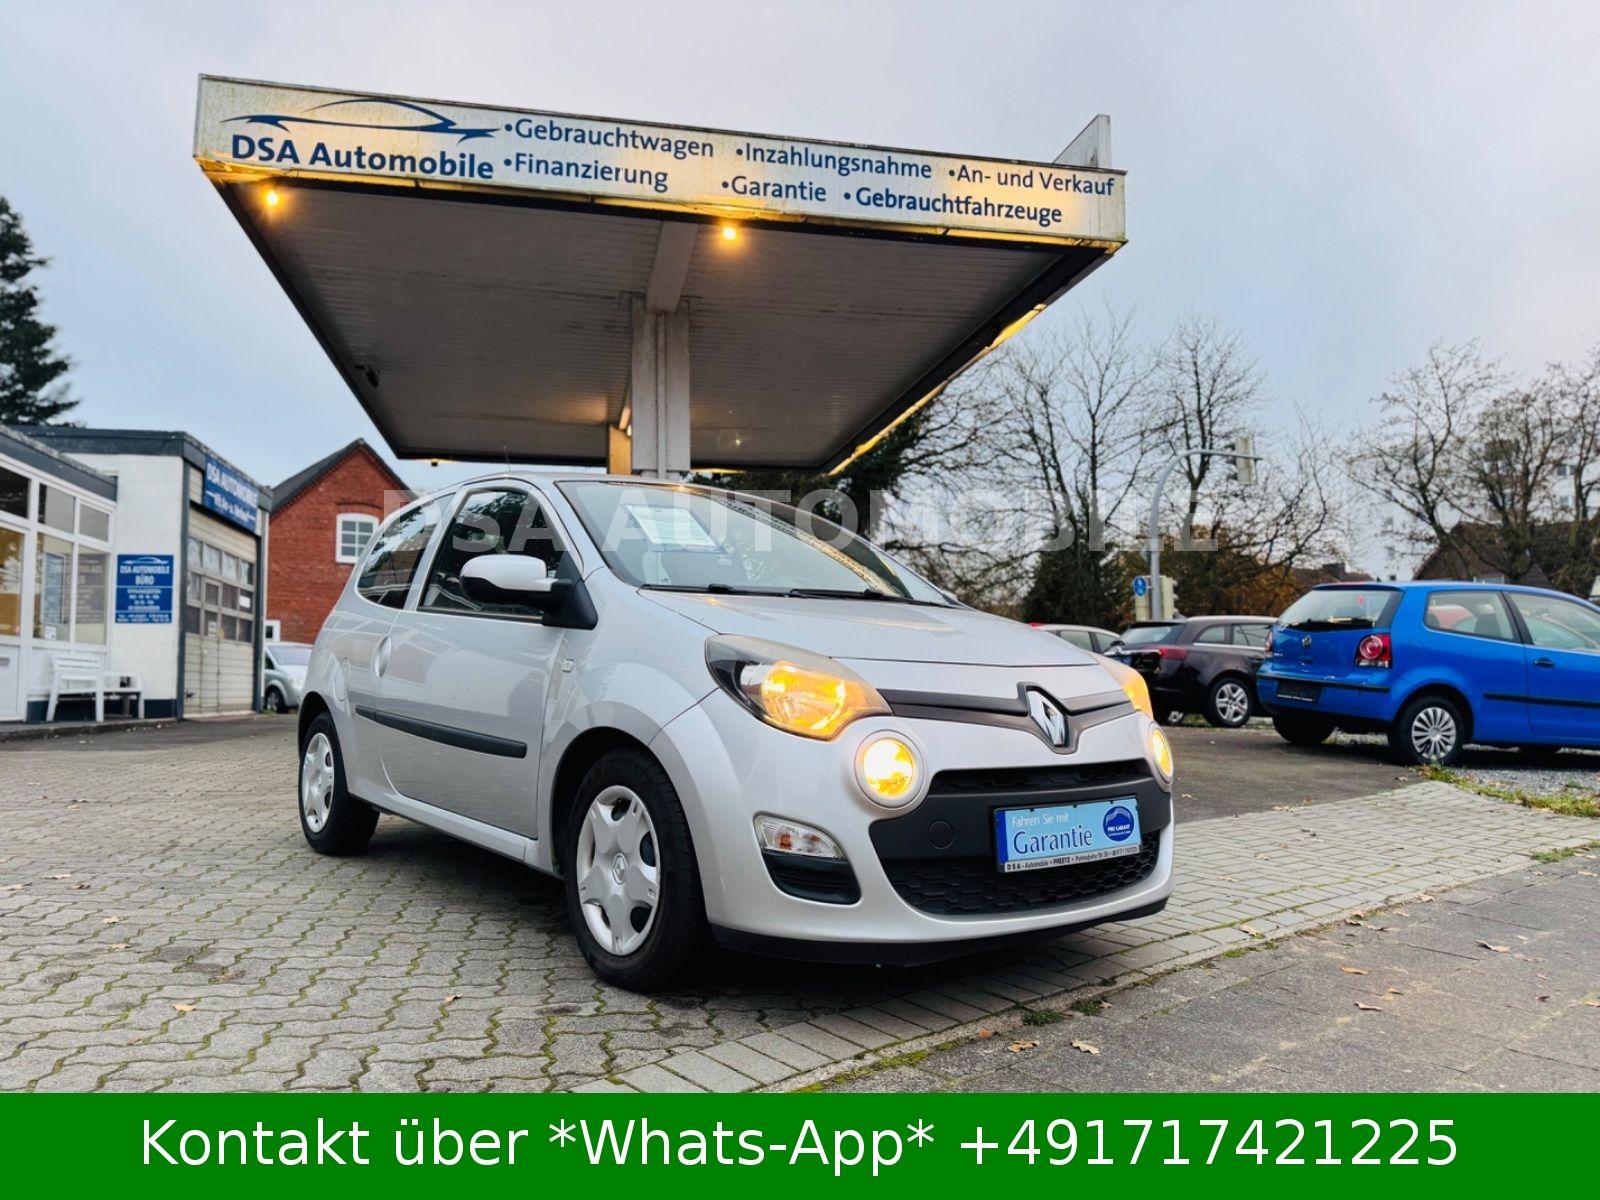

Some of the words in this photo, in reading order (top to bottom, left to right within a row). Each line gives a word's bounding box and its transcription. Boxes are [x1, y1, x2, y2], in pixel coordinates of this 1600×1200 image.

[515, 118, 714, 160] Gebrauchtwagen
[231, 134, 300, 165] DSA
[309, 142, 494, 180] Automobile
[515, 153, 669, 193] Finanzierung
[746, 143, 932, 178] Inzahlungsnahme
[731, 175, 827, 202] Garantie
[957, 164, 991, 183] An-
[997, 168, 1034, 188] und
[1039, 172, 1115, 197] Verkauf
[855, 187, 1063, 228] Gebrauchtfahrzeuge
[1012, 814, 1040, 828] Fahren
[1042, 812, 1054, 825] Sie
[1057, 812, 1070, 823] mit
[1013, 825, 1093, 855] Garantie
